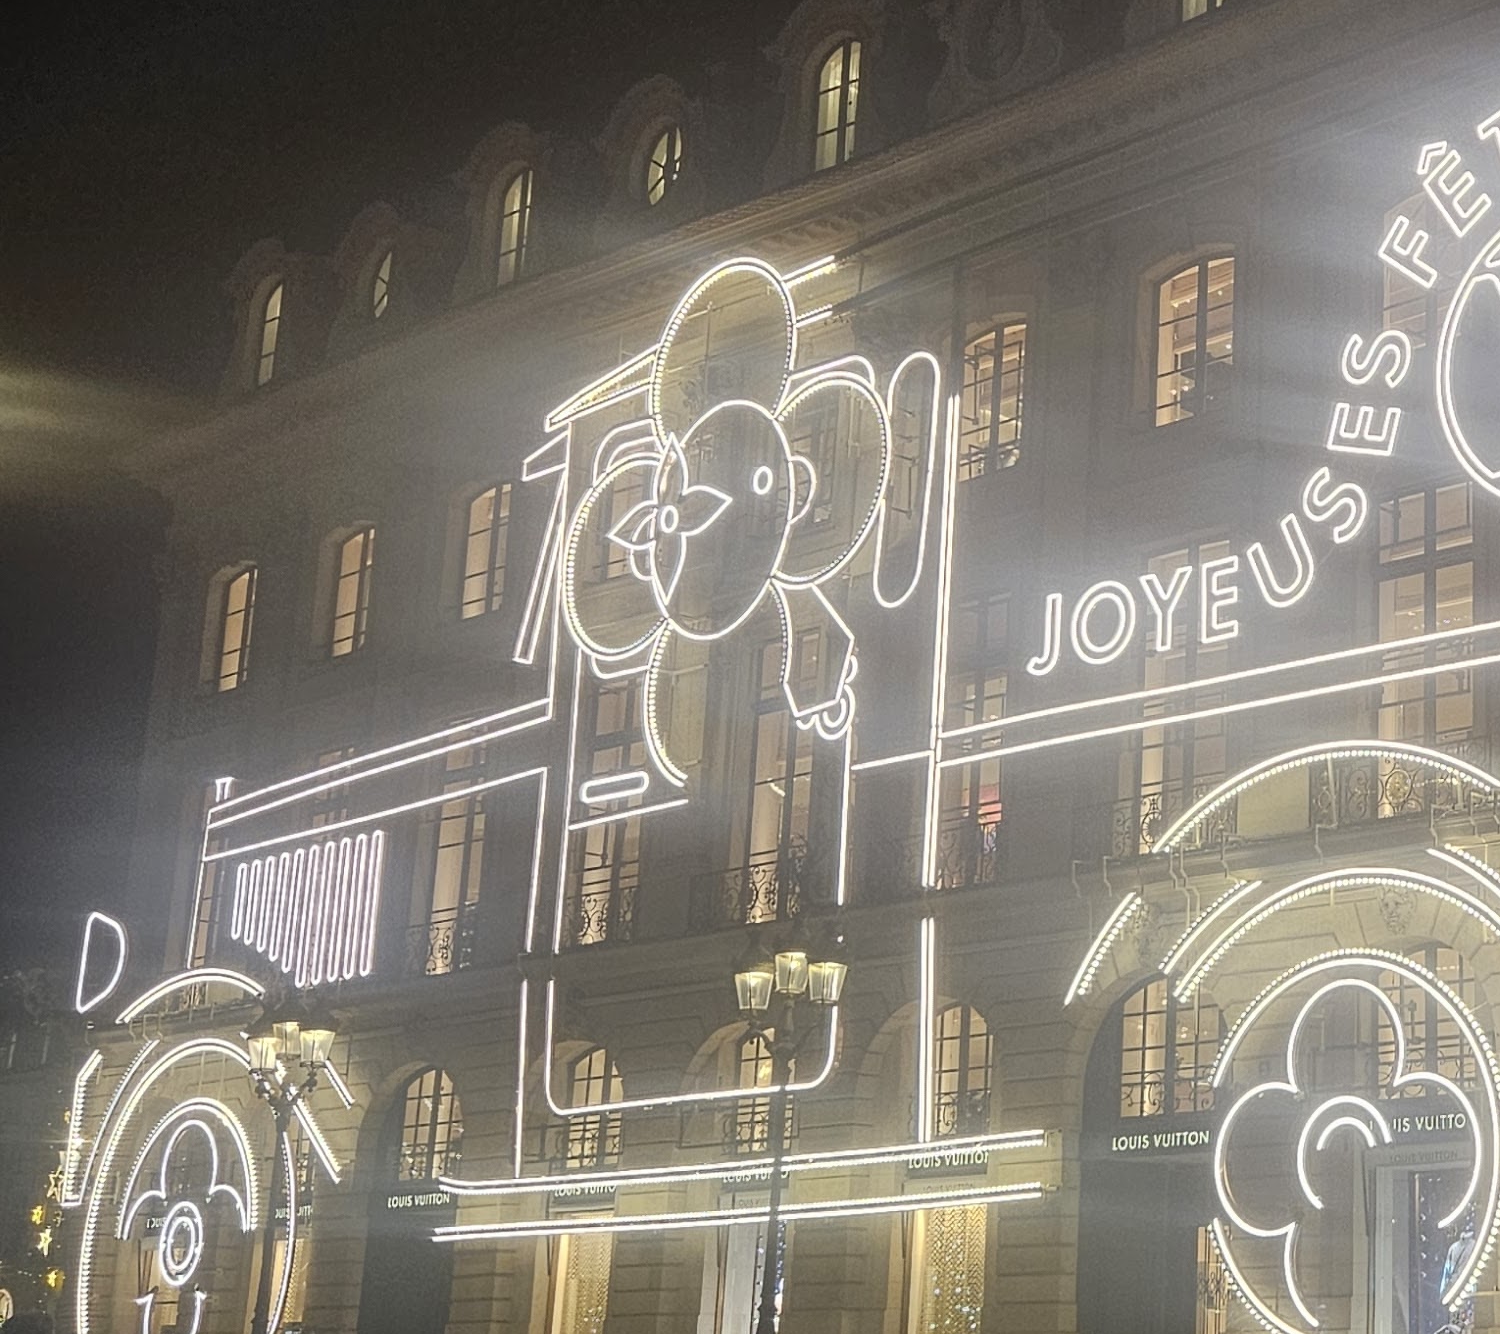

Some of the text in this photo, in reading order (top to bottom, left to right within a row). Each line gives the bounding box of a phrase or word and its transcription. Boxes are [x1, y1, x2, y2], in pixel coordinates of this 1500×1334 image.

[1026, 328, 1414, 676] JOYEUSES
[1415, 1113, 1466, 1130] VUITTO
[1112, 1130, 1210, 1151] LOUIS VUITTON
[908, 1153, 941, 1169] LOUIS
[387, 1192, 450, 1208] LOUIS VUITTON
